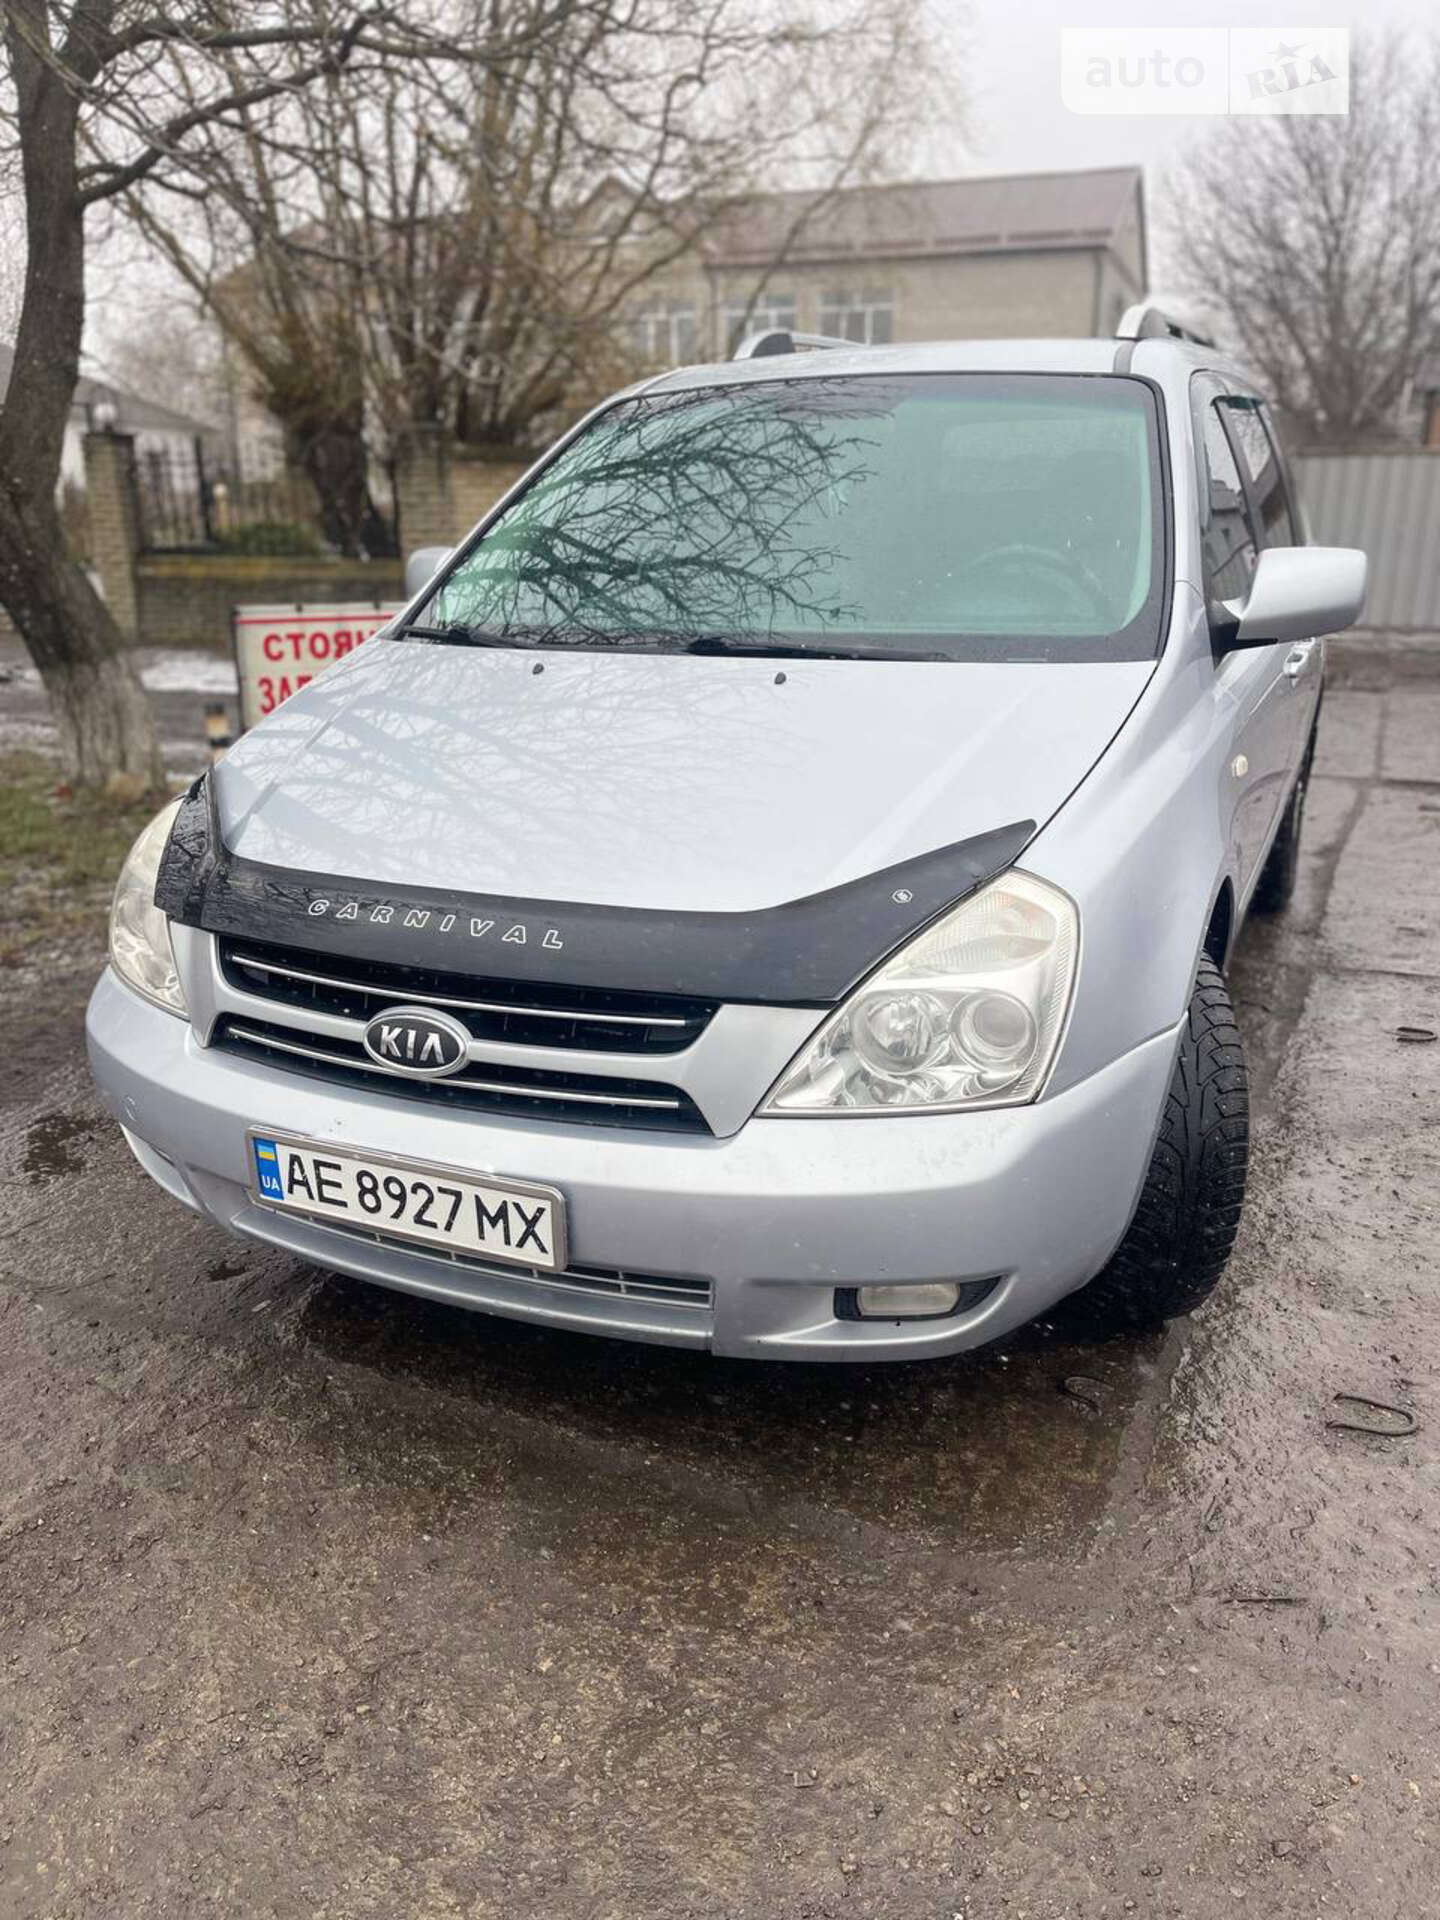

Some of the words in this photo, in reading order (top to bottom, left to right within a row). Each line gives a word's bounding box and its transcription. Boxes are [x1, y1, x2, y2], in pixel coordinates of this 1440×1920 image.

[308, 899, 564, 950] CARNIVAL
[379, 1024, 445, 1065] KIA
[261, 1174, 281, 1192] UA
[286, 1152, 348, 1209] AE
[355, 1168, 463, 1233] 8927
[474, 1194, 549, 1255] MX
